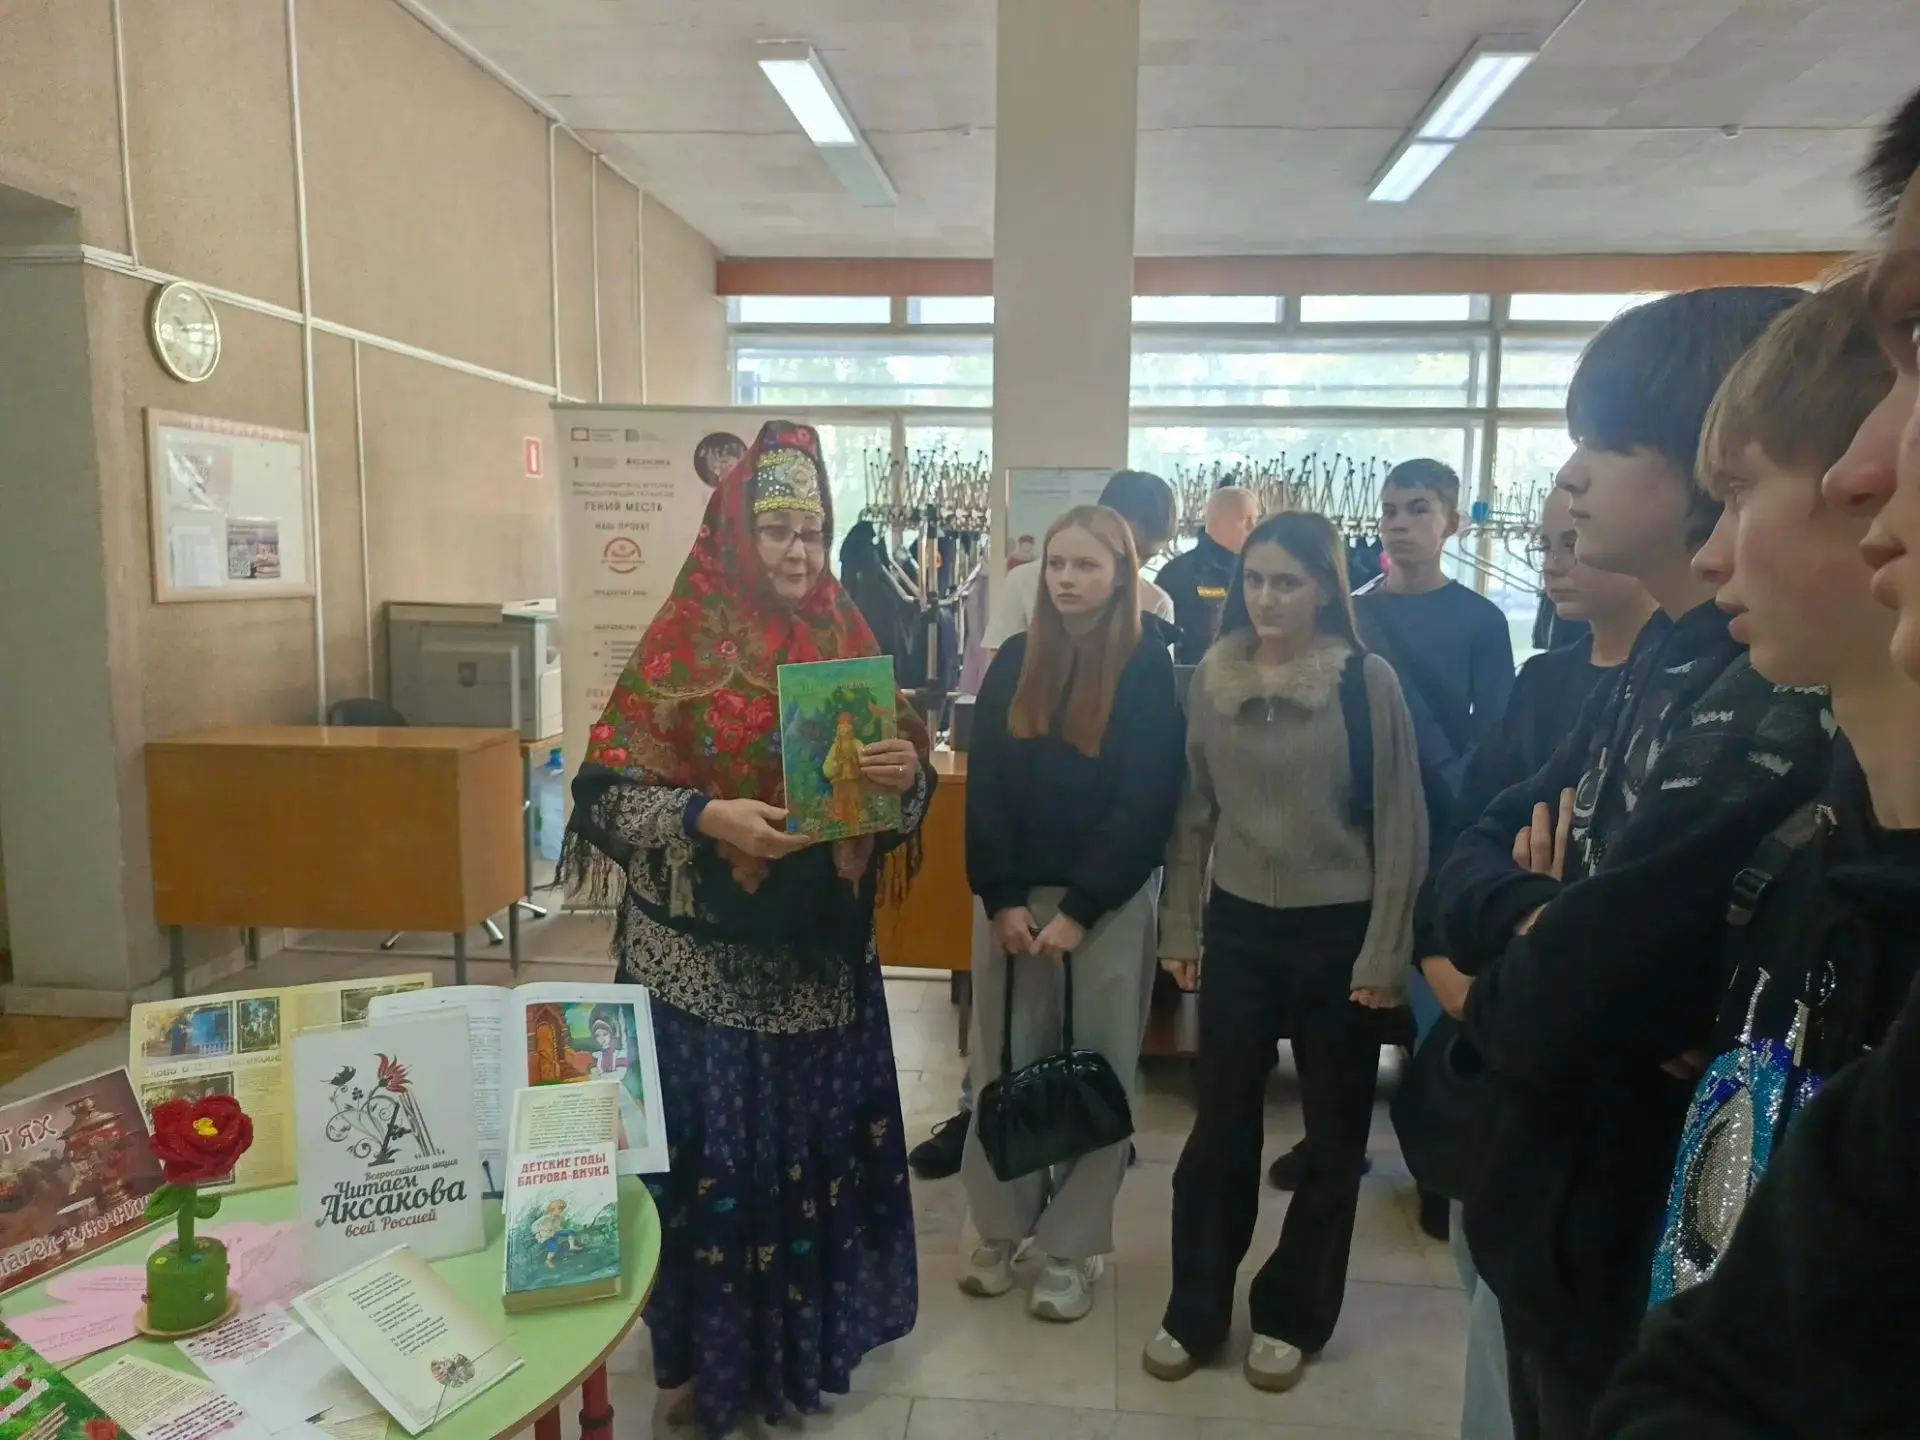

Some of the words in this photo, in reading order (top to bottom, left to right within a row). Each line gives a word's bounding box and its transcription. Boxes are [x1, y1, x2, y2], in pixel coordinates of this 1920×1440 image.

[584, 501, 621, 512] ГЕНИЙ
[625, 502, 663, 512] МЕСТА
[364, 1162, 431, 1182] Всероссийская
[432, 1158, 458, 1170] акция
[520, 1157, 572, 1174] ДЕТСКИЕ
[574, 1153, 606, 1167] ГОДЫ
[334, 1174, 419, 1200] Читаем
[517, 1165, 610, 1187] БАГРОВА-ВНУКА
[315, 1177, 468, 1228] Аксакова
[345, 1219, 376, 1238] всей
[380, 1208, 437, 1231] Россией
